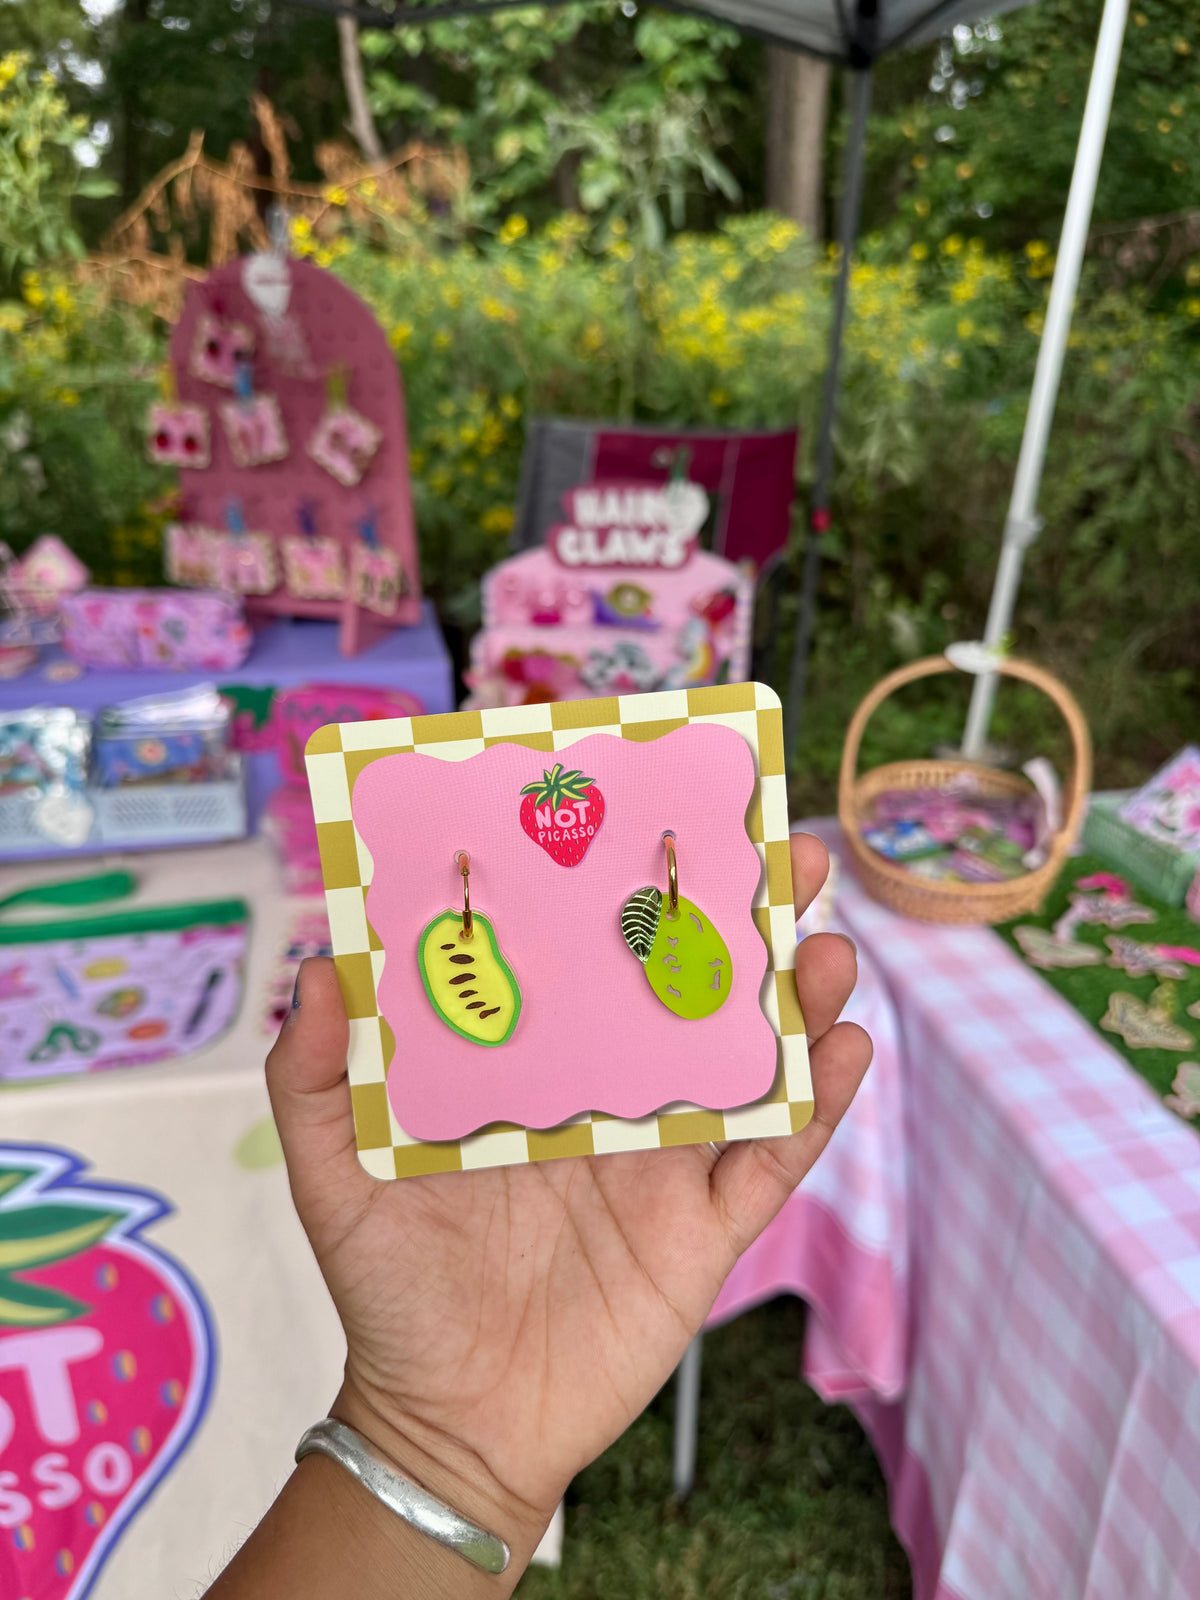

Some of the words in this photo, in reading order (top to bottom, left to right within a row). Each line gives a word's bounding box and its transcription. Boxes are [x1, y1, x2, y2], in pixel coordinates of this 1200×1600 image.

[556, 527, 684, 566] CLAWS
[535, 801, 591, 830] NOT
[537, 825, 595, 843] PICASSO
